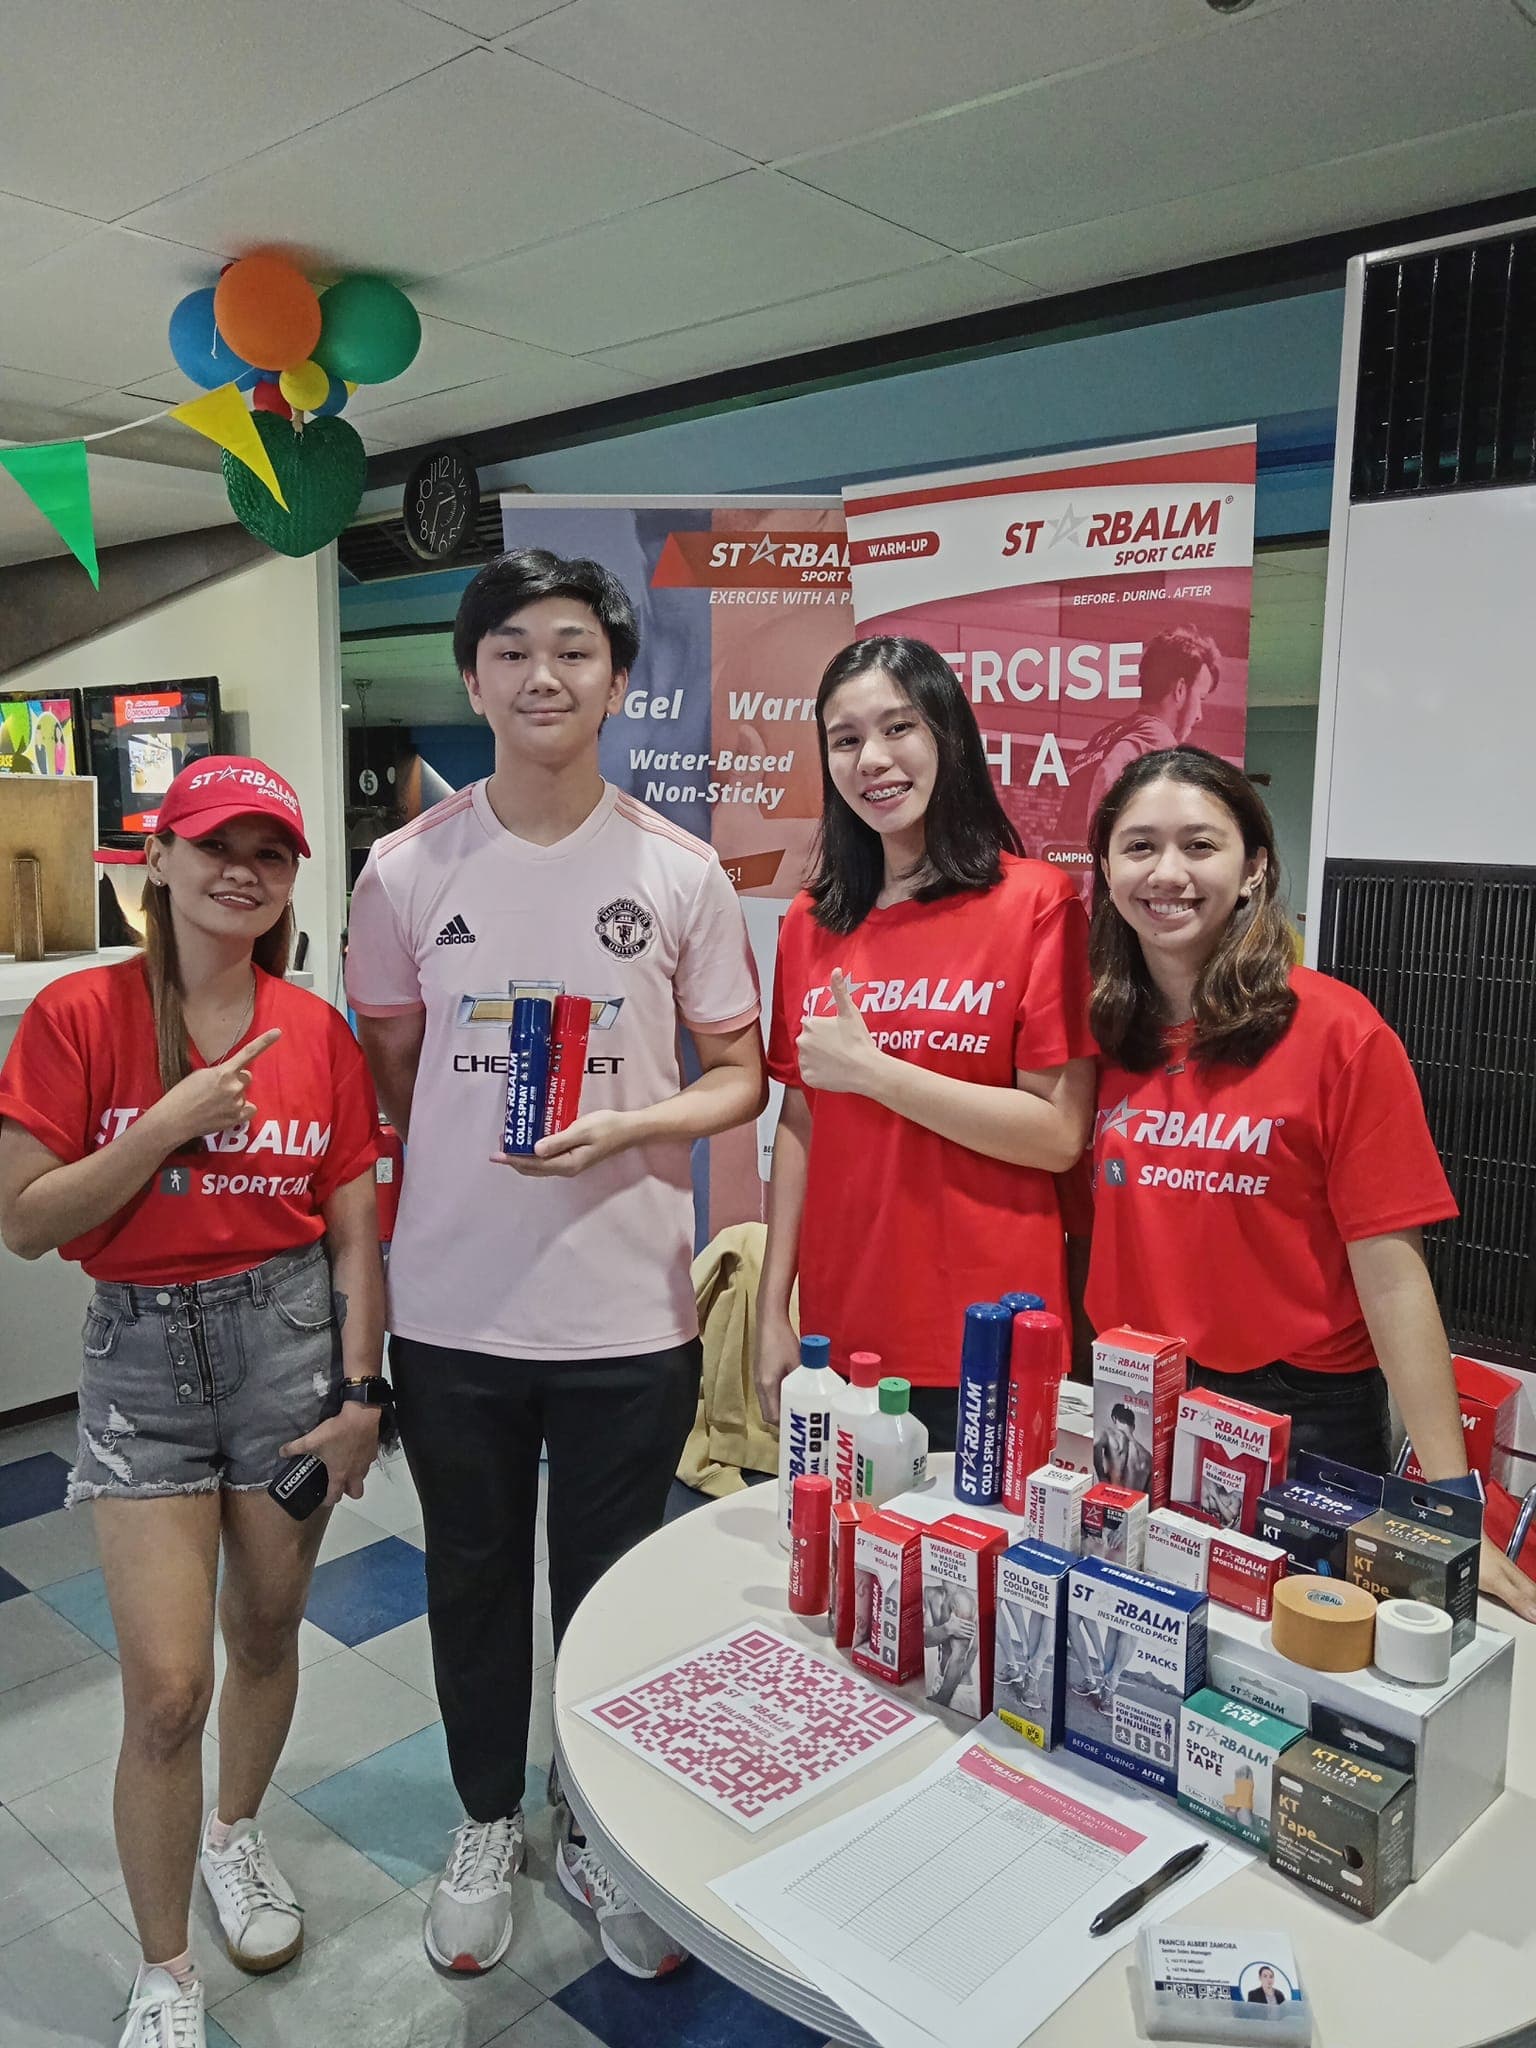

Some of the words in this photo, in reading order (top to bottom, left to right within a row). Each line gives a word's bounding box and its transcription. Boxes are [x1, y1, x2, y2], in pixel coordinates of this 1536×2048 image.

[439, 456, 450, 478] 12
[1002, 500, 1221, 557] STARBALM
[709, 534, 849, 567] STARBAL
[868, 539, 928, 557] WARM-UP
[1114, 547, 1168, 566] SPORT
[1171, 542, 1216, 561] CARE
[801, 571, 844, 582] SPORT
[709, 591, 777, 604] EXERCISE
[783, 592, 821, 604] WITH
[825, 592, 836, 604] A
[1074, 593, 1115, 606] BEFORE
[1123, 589, 1166, 601] DURING
[1173, 585, 1212, 598] AFTER
[624, 689, 684, 720] Gel
[630, 749, 795, 772] Water-Based
[1028, 733, 1070, 786] A
[257, 788, 282, 801] SPORT
[645, 782, 785, 810] Non-Sticky
[602, 903, 648, 925] MANCHESTER
[436, 933, 476, 946] adidas
[609, 942, 640, 953] UNITED
[871, 1030, 925, 1050] SPORT
[928, 1031, 990, 1054] CARE
[453, 1055, 624, 1074] CHEET
[518, 1085, 528, 1116] SPRAY
[548, 1076, 558, 1105] SPRAY
[516, 1119, 527, 1145] COLD
[544, 1107, 554, 1135] WARM
[1138, 1165, 1270, 1196] SPORTCARE
[1099, 1366, 1126, 1377] MASSAGE
[1127, 1371, 1149, 1382] LOTION
[1124, 1395, 1149, 1407] EXTRA
[960, 1382, 982, 1495] STARBALM
[1180, 1407, 1265, 1446] STARBALM
[984, 1424, 995, 1461] SPRAY
[1007, 1423, 1016, 1458] SPRAY
[1215, 1432, 1238, 1446] WARM
[1240, 1442, 1261, 1454] STICK
[982, 1464, 993, 1495] COLD
[1005, 1463, 1014, 1496] WARM
[1206, 1471, 1222, 1483] WARM
[1222, 1478, 1240, 1489] STICK
[1283, 1491, 1345, 1515] CLASSIC
[1290, 1486, 1315, 1496] KT
[1315, 1493, 1353, 1511] Tape
[1149, 1533, 1169, 1546] SPORTS
[1170, 1541, 1186, 1553] BALM
[1263, 1523, 1281, 1540] KT
[1384, 1519, 1411, 1529] KT
[1412, 1527, 1452, 1545] Tape
[930, 1543, 952, 1556] WARM
[953, 1550, 966, 1560] GEL
[939, 1554, 966, 1567] MASSAGE
[931, 1565, 966, 1582] MUSCLES
[939, 1560, 958, 1572] YOUR
[1212, 1556, 1234, 1570] SPORTS
[1234, 1564, 1251, 1576] BALM
[1354, 1555, 1374, 1573] KT
[792, 1560, 800, 1595] ROLL-ON
[1003, 1570, 1029, 1586] COLD
[1031, 1581, 1050, 1595] GEL
[1101, 1567, 1176, 1596] STARBALM.COM
[1352, 1572, 1390, 1597] Tape
[1004, 1580, 1038, 1599] COOLING
[1039, 1594, 1049, 1602] OF
[1004, 1588, 1024, 1599] SPORTS
[1025, 1595, 1048, 1609] INJURIES
[1097, 1610, 1129, 1627] INSTANT
[1130, 1623, 1151, 1636] COLD
[1153, 1631, 1178, 1645] PACKS
[1137, 1650, 1144, 1659] 2
[1145, 1654, 1178, 1671] PACKS
[1230, 1685, 1285, 1714] STARBALM
[712, 1701, 774, 1738] PHILIPPINES
[1116, 1707, 1129, 1717] FOR
[1129, 1712, 1162, 1730] SWELLING
[1131, 1707, 1162, 1721] TREATMENT
[1220, 1706, 1260, 1727] TAPE
[1225, 1702, 1268, 1723] SPORT
[1123, 1717, 1161, 1738] INJURIES
[1186, 1720, 1268, 1767] STARBALM
[1186, 1739, 1225, 1764] SPORT
[1072, 1738, 1099, 1755] BEFORE
[1105, 1753, 1135, 1770] DURING
[1141, 1768, 1166, 1784] AFTER
[1187, 1750, 1223, 1776] TAPE
[1312, 1748, 1339, 1762] KT
[1340, 1758, 1383, 1783] Tape
[1316, 1761, 1357, 1784] ULTRA
[1028, 1784, 1068, 1807] PHILIPPINE
[1067, 1805, 1128, 1839] INTERNATIONAL
[1279, 1794, 1300, 1813] KT
[1189, 1802, 1210, 1817] BEFORE
[1242, 1830, 1260, 1842] AFTER
[1278, 1812, 1317, 1840] Tape
[1276, 1858, 1300, 1874] BEFORE
[1307, 1874, 1333, 1892] DURING
[1341, 1892, 1361, 1906] AFTER
